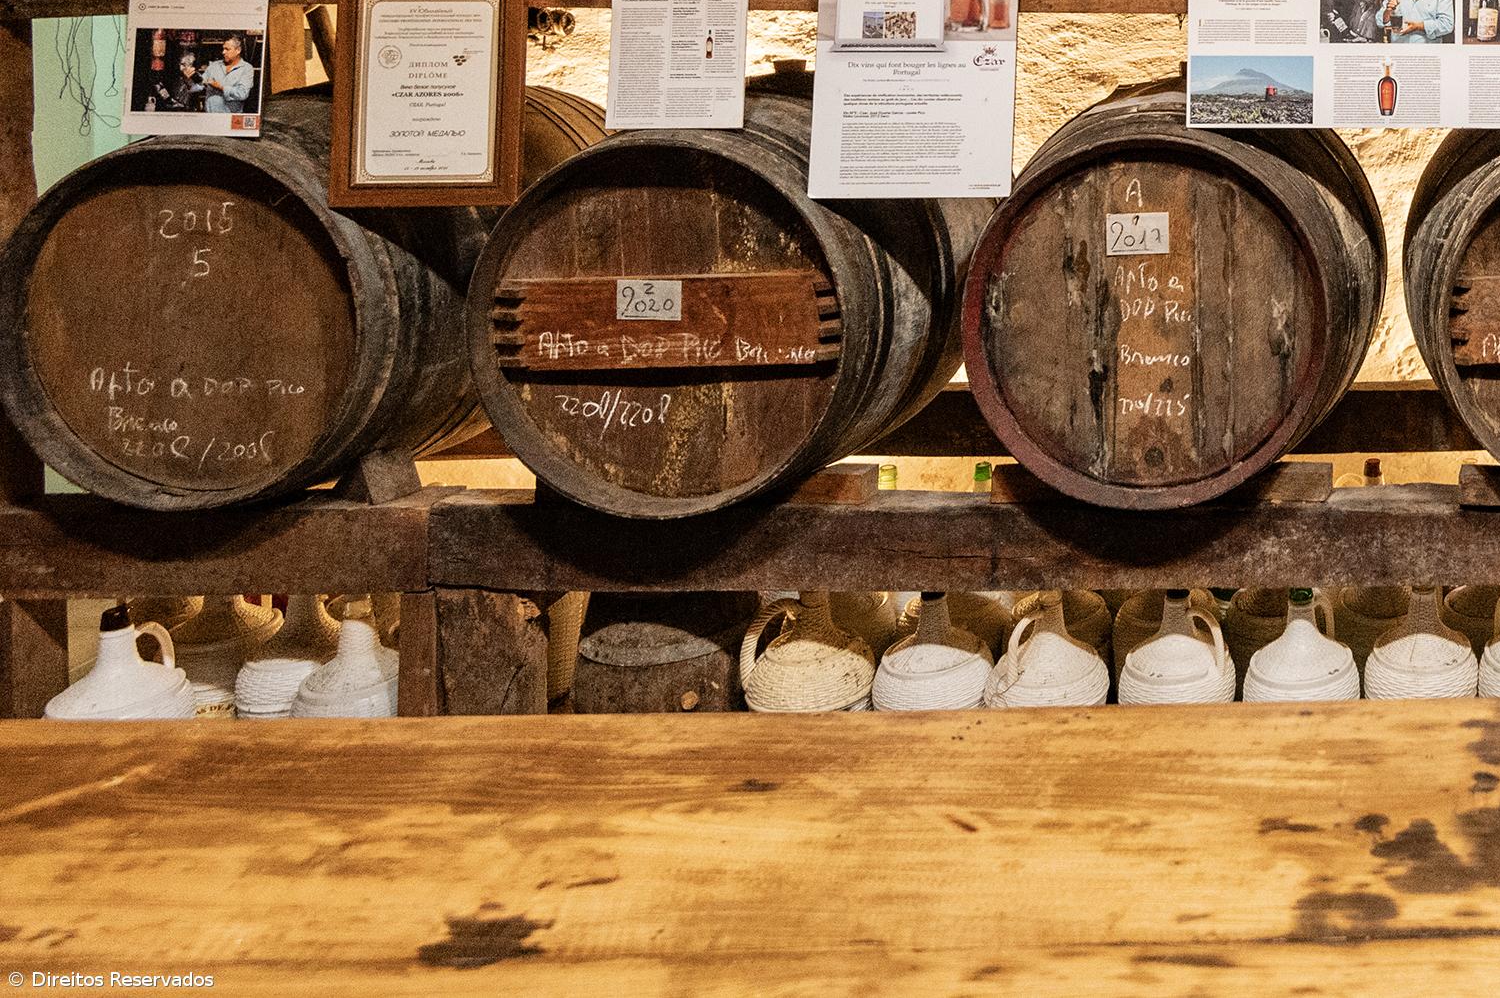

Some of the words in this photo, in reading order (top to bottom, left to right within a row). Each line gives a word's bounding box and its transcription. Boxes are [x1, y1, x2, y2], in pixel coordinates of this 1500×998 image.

[876, 62, 887, 70] qui
[903, 62, 925, 70] bouger
[938, 62, 957, 70] lignes
[972, 55, 1006, 67] Czar
[892, 69, 921, 77] Portugal
[1125, 178, 1143, 208] A
[158, 201, 235, 239] 2015
[192, 248, 212, 278] 5
